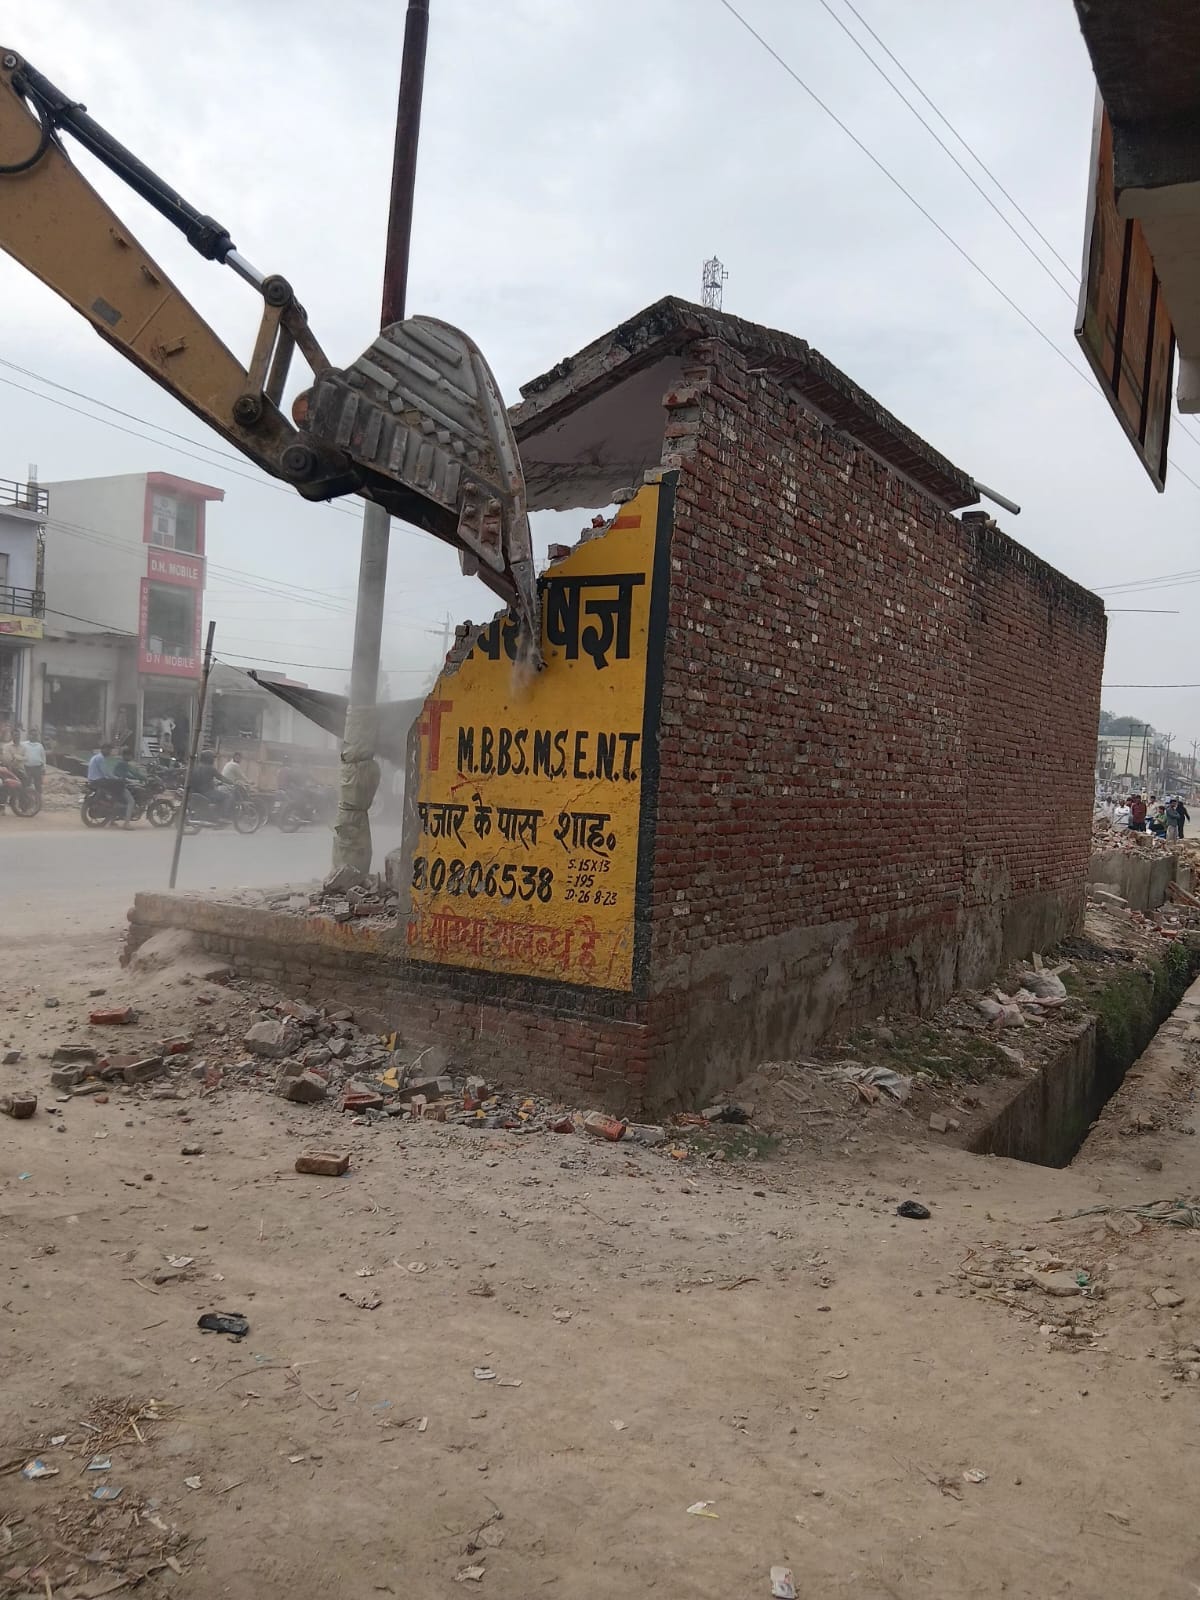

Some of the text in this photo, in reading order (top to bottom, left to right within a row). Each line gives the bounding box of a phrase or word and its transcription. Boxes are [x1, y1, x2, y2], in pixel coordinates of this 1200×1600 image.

[168, 563, 199, 580] MOBILE
[164, 655, 196, 669] MOBILE
[471, 792, 492, 840] के
[496, 807, 544, 850] पास
